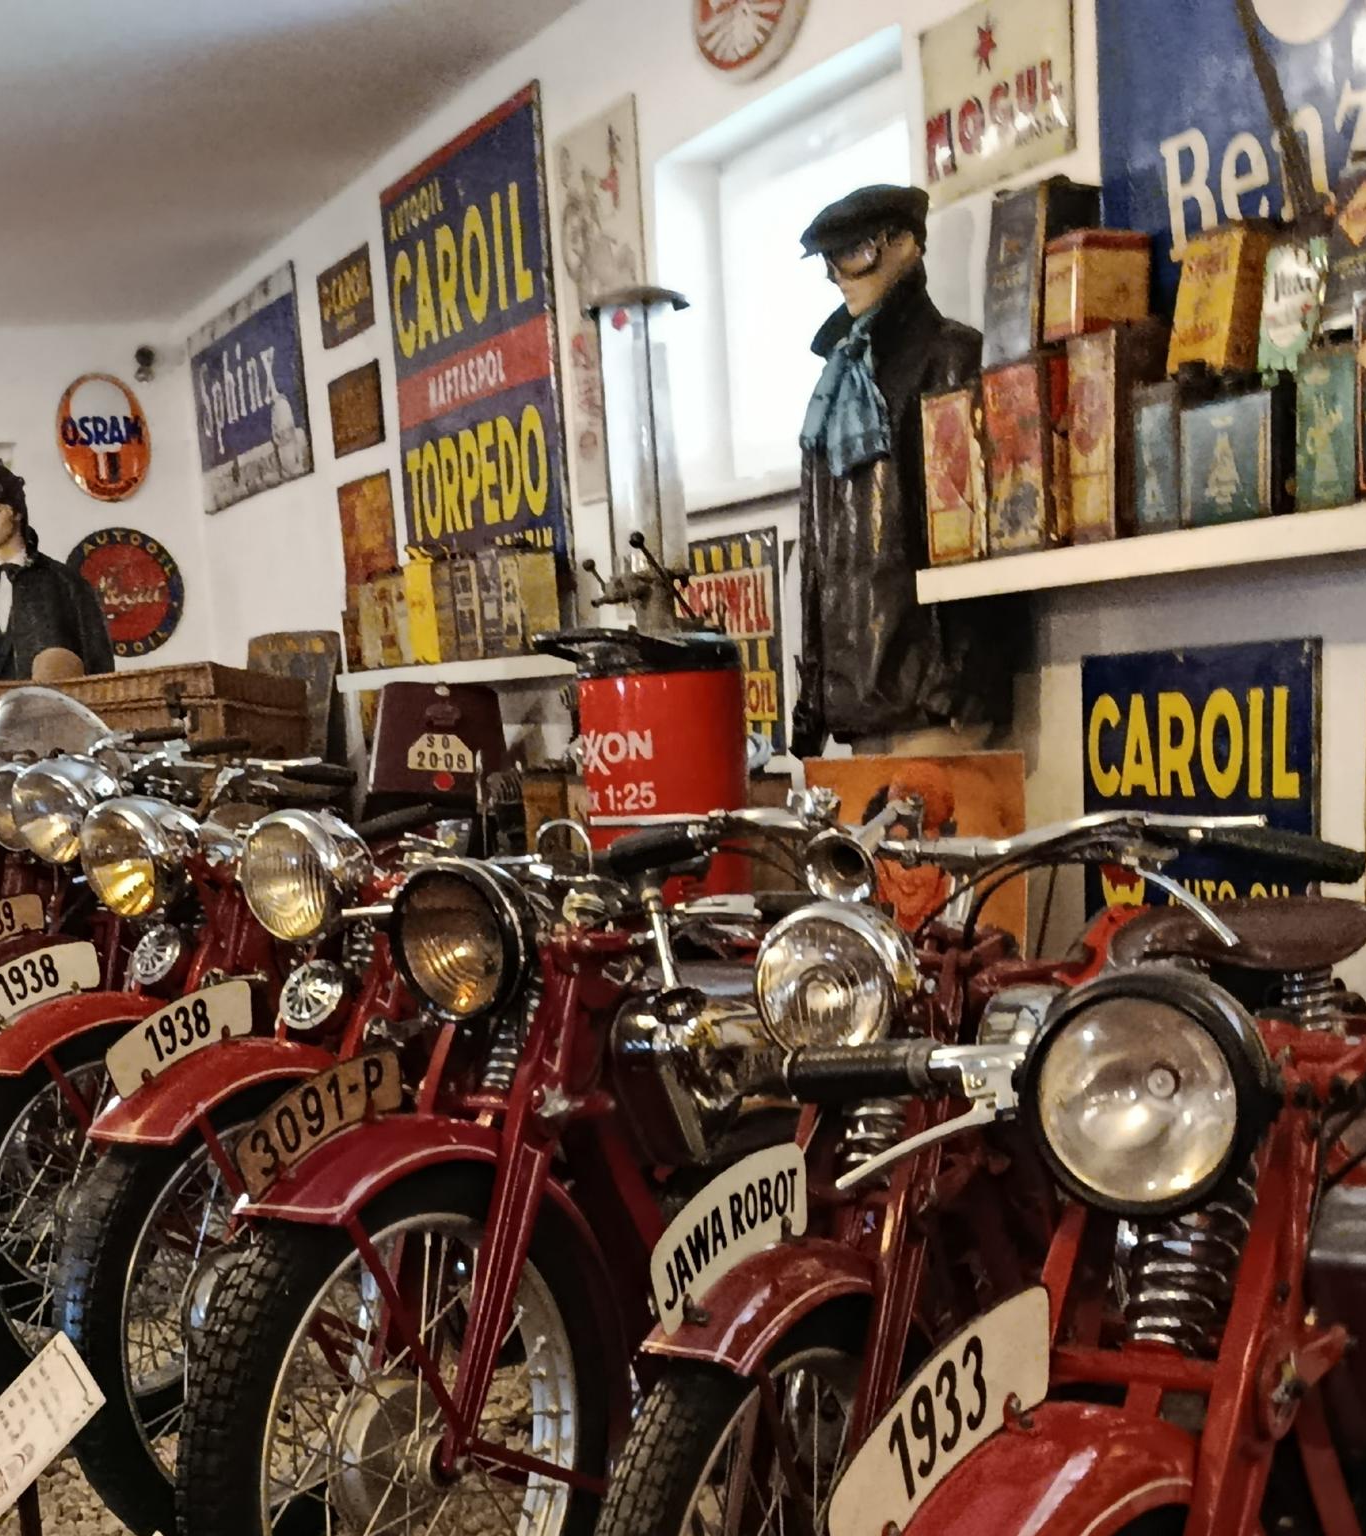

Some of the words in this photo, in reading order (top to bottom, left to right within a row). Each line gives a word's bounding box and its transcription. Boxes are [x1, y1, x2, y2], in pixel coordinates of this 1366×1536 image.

[926, 59, 1063, 182] MOGUL
[394, 182, 533, 358] CAROIL
[62, 415, 143, 447] OSRAM
[199, 342, 278, 455] Sphinx
[427, 351, 506, 408] NAFTASPOL
[406, 404, 548, 541] TORPEDO
[679, 571, 771, 633] PEEDWELL
[416, 750, 468, 770] 20-08
[605, 782, 657, 811] 1:25
[1088, 685, 1299, 801] CAROIL
[145, 998, 212, 1063] 1938
[250, 1057, 384, 1178] 3091-P
[664, 1205, 729, 1312] JAWA
[728, 1167, 798, 1238] ROBOT
[888, 1335, 988, 1501] 1933
